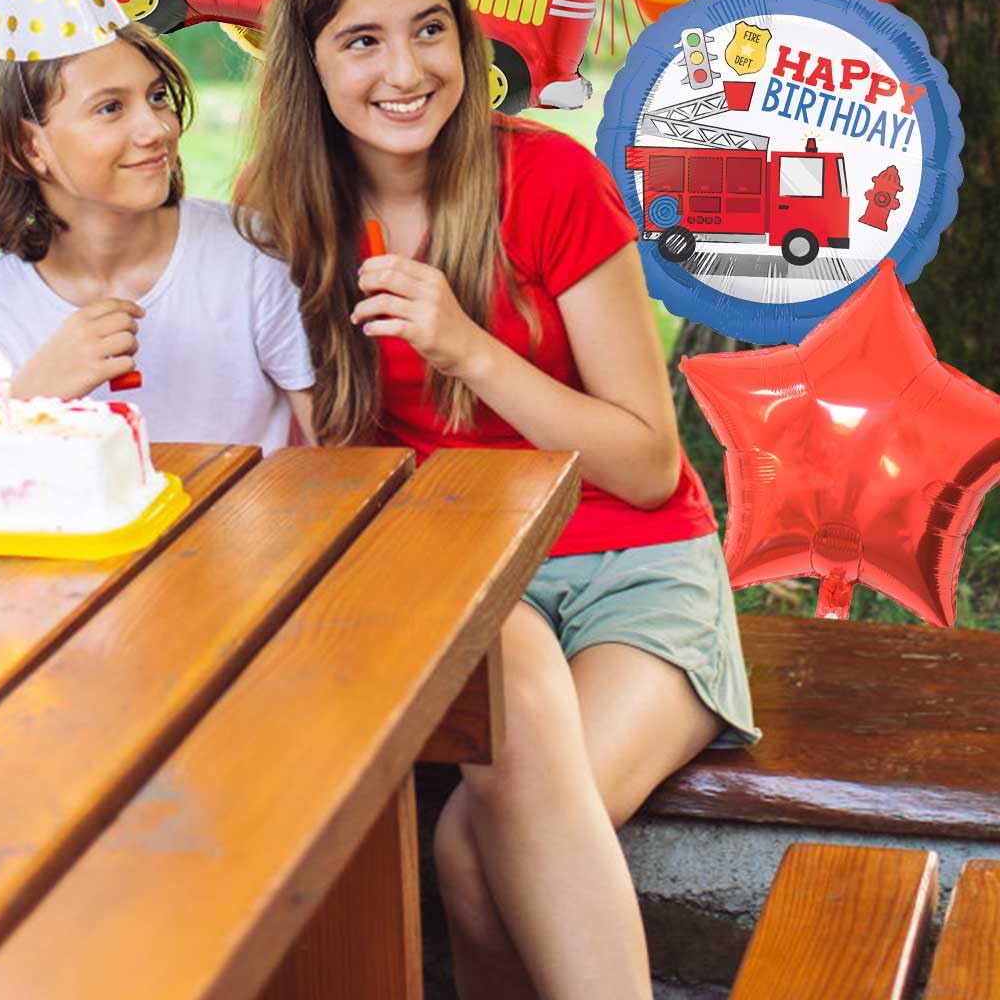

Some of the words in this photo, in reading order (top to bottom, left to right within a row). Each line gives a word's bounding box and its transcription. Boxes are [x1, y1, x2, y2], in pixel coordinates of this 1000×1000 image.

[743, 30, 761, 44] FIRE
[734, 55, 754, 68] DEPT
[772, 45, 927, 115] HAPPY
[761, 77, 916, 153] BIRTHDAY!
